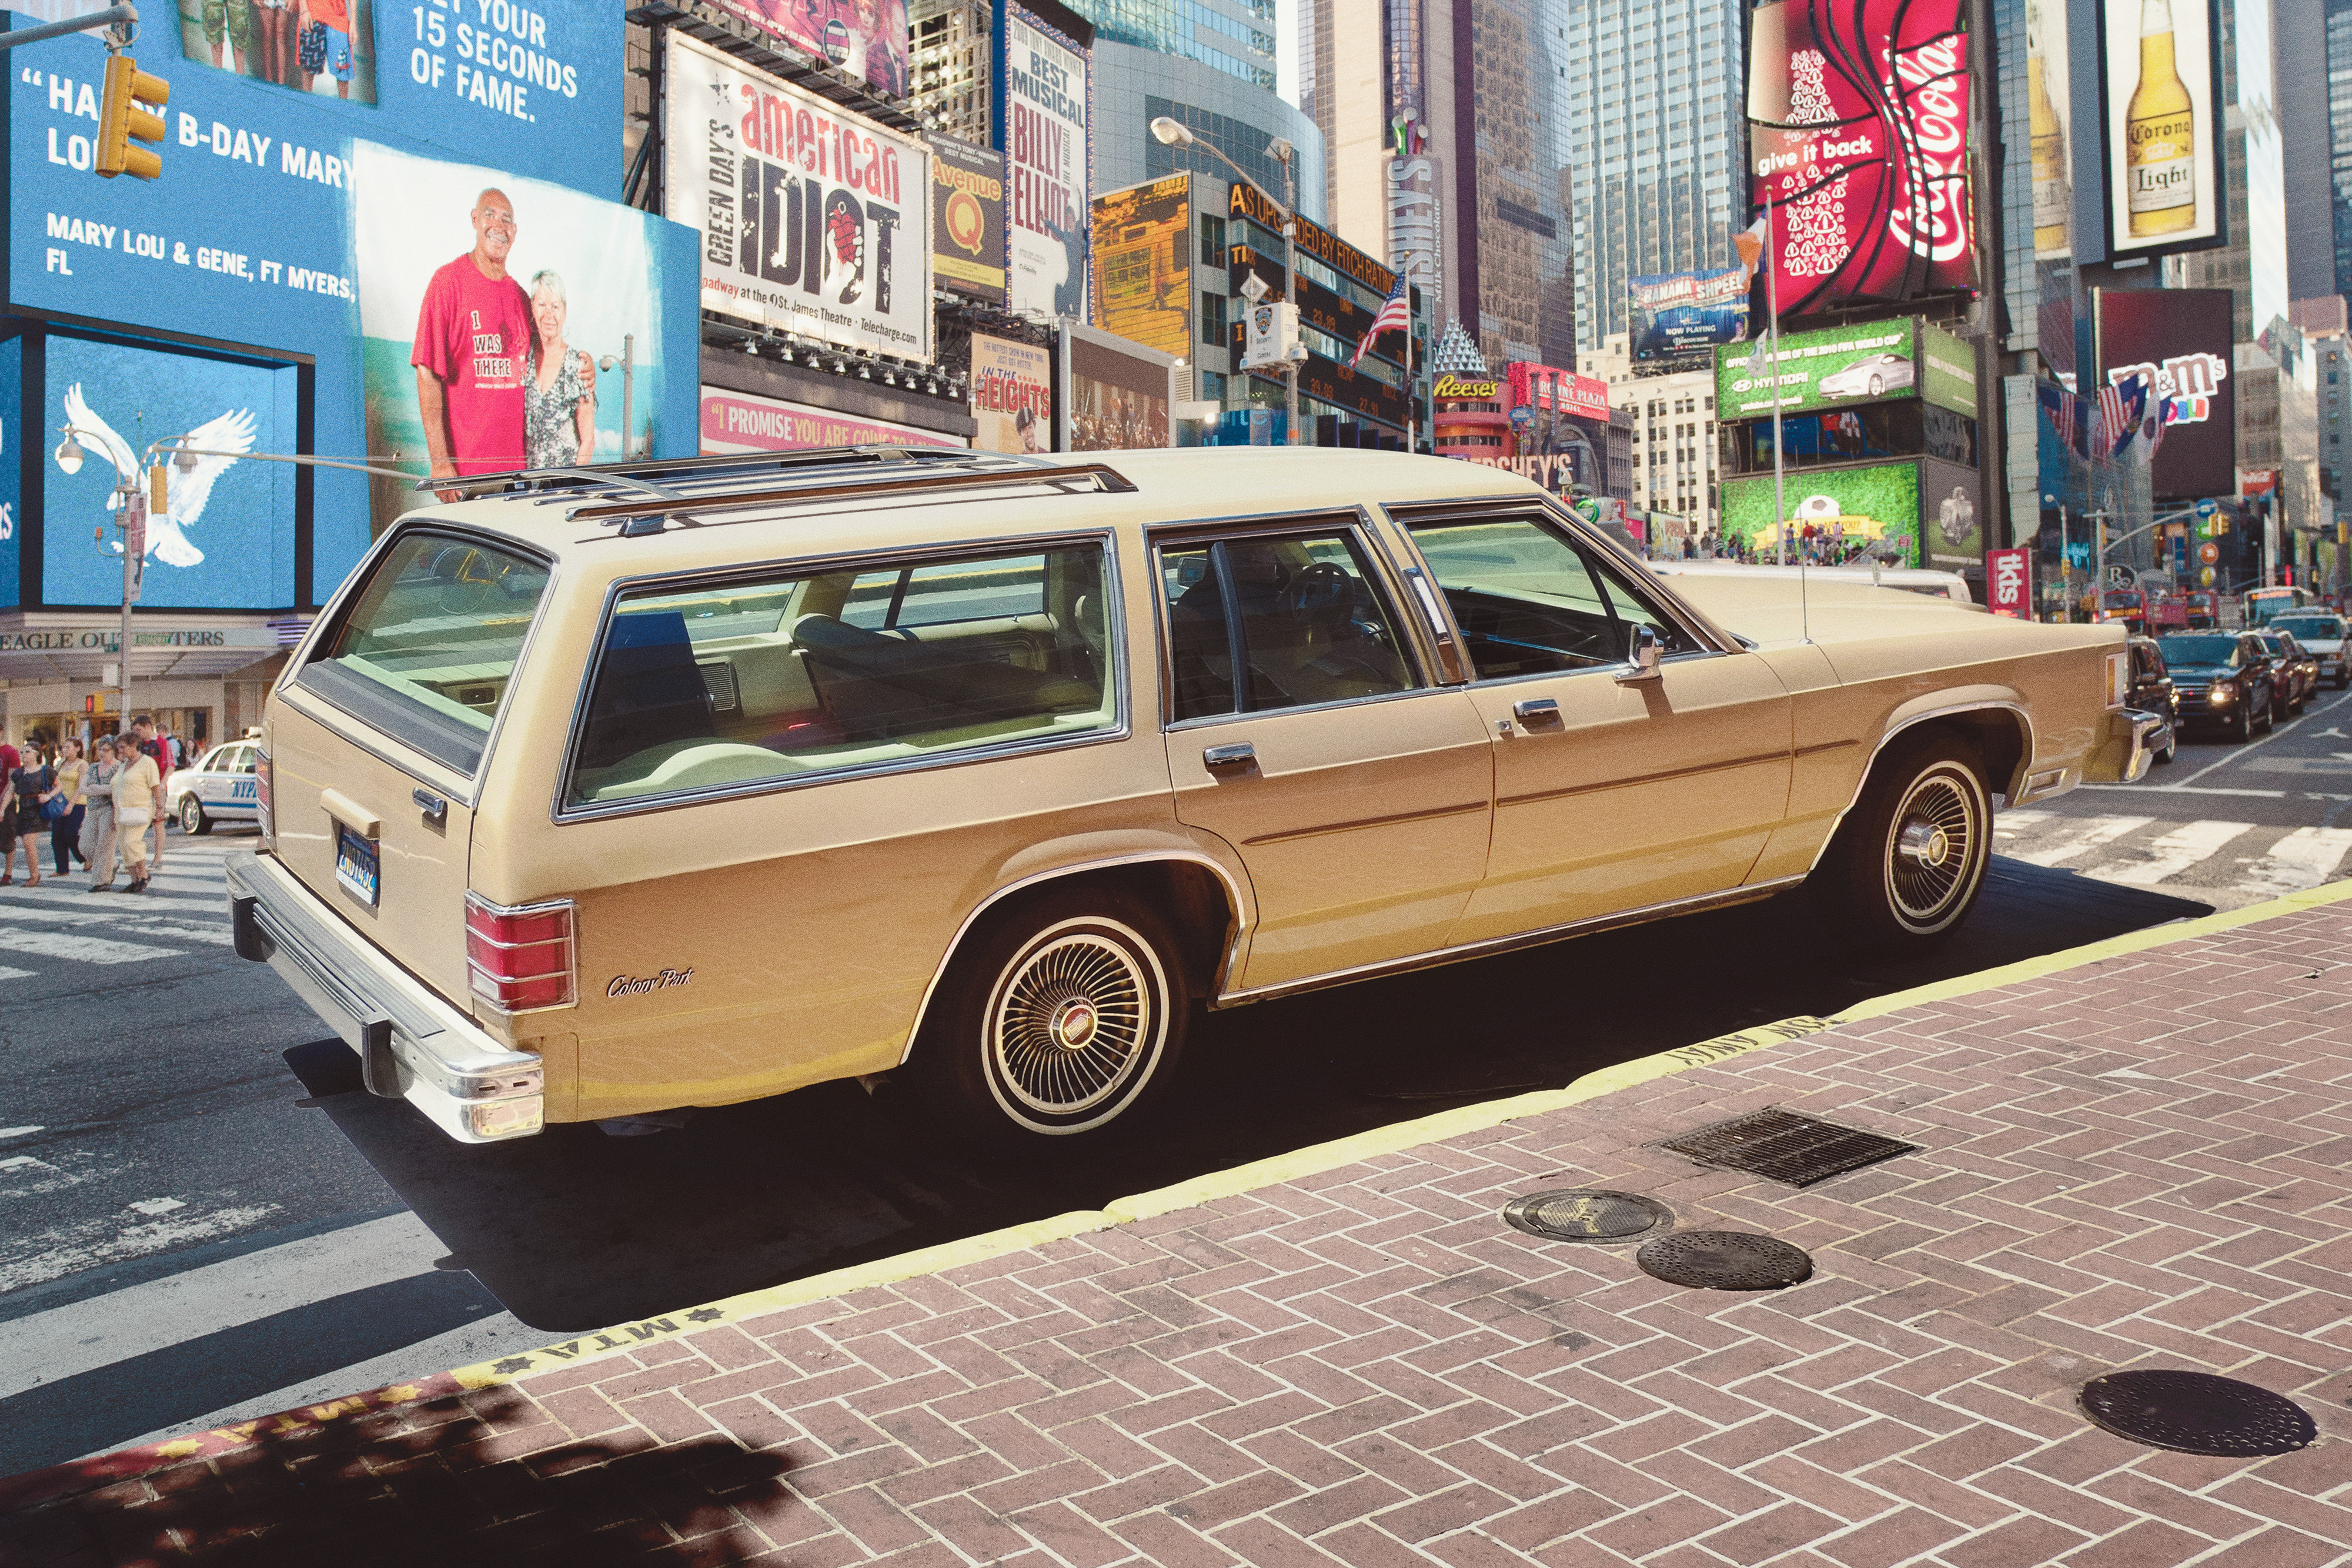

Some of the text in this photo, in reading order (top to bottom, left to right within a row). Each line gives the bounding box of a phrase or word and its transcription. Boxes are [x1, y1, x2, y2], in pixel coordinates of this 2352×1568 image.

[478, 0, 546, 49] YOUR
[413, 6, 578, 99] 15 SECONDS
[1031, 51, 1068, 94] BEST
[412, 48, 536, 123] OF FAME.
[1011, 66, 1084, 129] MUSICAL
[48, 127, 99, 170] LO
[179, 112, 271, 167] B-DAY
[282, 141, 354, 192] MARY
[741, 84, 900, 205] american
[1014, 102, 1063, 180] BILLY
[1063, 128, 1071, 167] MUSICAL
[2132, 121, 2190, 145] Corona
[1758, 135, 1873, 177] give it back
[707, 119, 735, 268] GREEN DAY'S
[933, 155, 1002, 202] Avenue
[2137, 166, 2188, 193] Light
[946, 188, 984, 256] Q
[1014, 165, 1071, 242] ELLIOT
[739, 153, 901, 315] IDIOT
[1257, 193, 1319, 254] UPGDED
[1321, 231, 1335, 262] BY
[1337, 241, 1364, 282] FITCH
[47, 212, 356, 303] MARY LOU & GENE, FT MYERS,
[47, 248, 73, 276] FL
[1643, 279, 1692, 304] BANANA
[1696, 275, 1745, 300] SHPEEL
[471, 310, 481, 330] I
[741, 287, 751, 299] at
[753, 289, 767, 305] the
[779, 295, 790, 311] St.
[792, 299, 818, 319] James
[821, 307, 853, 327] Theatre
[861, 317, 917, 345] Telecharge.com
[1666, 325, 1717, 336] NOW PLAYING
[473, 333, 502, 353] WAS
[1726, 356, 1750, 369] OFFIC
[1792, 349, 1803, 359] OF
[1803, 346, 1819, 357] THE
[1818, 344, 1838, 355] 2010
[1838, 342, 1855, 353] FIFA
[1855, 337, 1883, 350] WORLD
[1883, 335, 1902, 346] CUP
[474, 358, 511, 377] THERE
[981, 365, 1017, 380] IN THE
[1433, 375, 1498, 397] Reese's
[975, 373, 1050, 420] HEIGHTS
[1577, 389, 1606, 407] PLAZA
[728, 406, 793, 442] PROMISE
[794, 417, 821, 446] YOU
[824, 424, 849, 447] ARE
[1997, 553, 2024, 604] tkts
[0, 633, 74, 650] EAGLE
[81, 631, 225, 648] OUTERS
[606, 967, 695, 998] Colony Park
[540, 1317, 681, 1359] MTA
[211, 1395, 369, 1444] MTA
